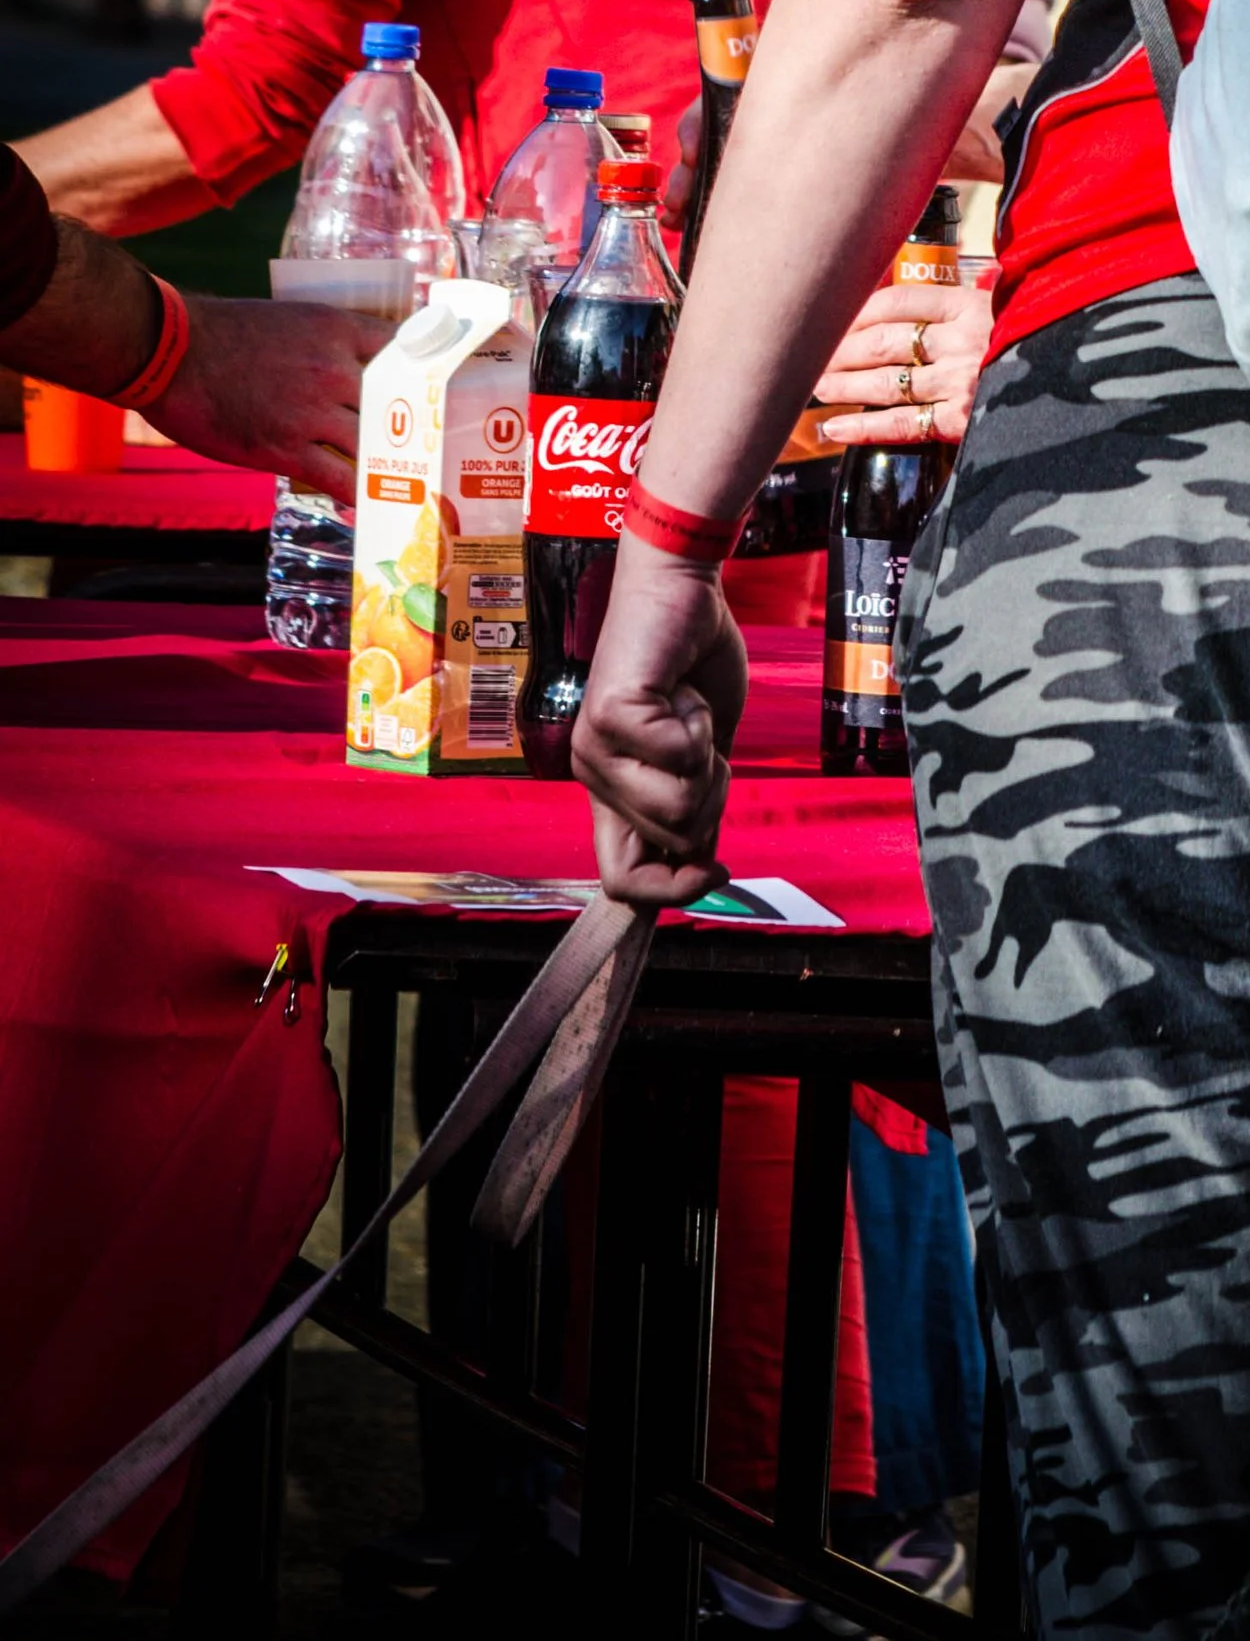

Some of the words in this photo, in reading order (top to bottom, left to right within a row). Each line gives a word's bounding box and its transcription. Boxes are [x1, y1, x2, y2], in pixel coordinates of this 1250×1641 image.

[900, 261, 956, 282] DOUX
[493, 420, 515, 443] U
[538, 405, 654, 475] Coca-C
[461, 460, 492, 472] 100%
[496, 460, 519, 472] PUR
[481, 478, 521, 488] ORANGE
[571, 483, 612, 499] GOÛT
